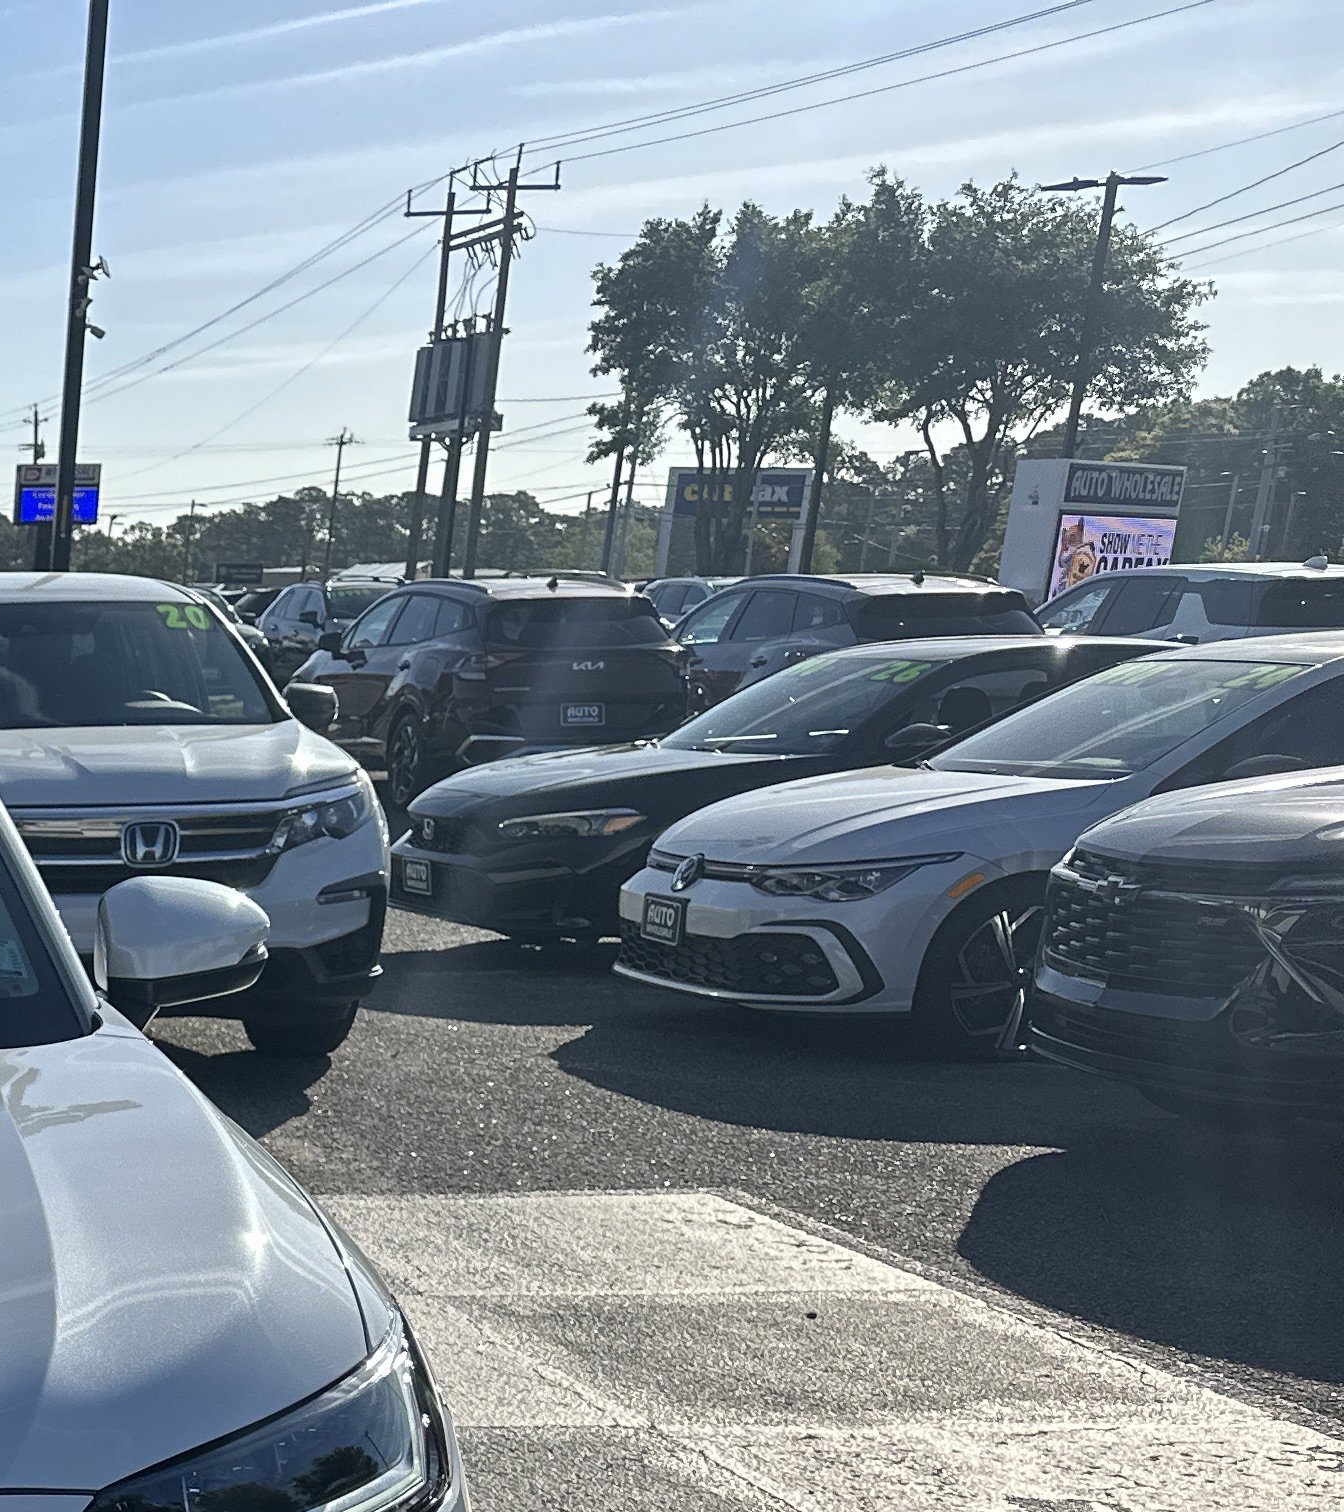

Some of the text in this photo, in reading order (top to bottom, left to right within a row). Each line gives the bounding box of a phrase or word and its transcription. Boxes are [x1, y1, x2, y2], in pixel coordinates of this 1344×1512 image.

[1071, 469, 1181, 502] AUTO WHOLESALE
[1099, 532, 1130, 555] SHOW
[155, 604, 211, 630] 20
[567, 706, 599, 717] AUTO
[647, 904, 675, 927] AUTO
